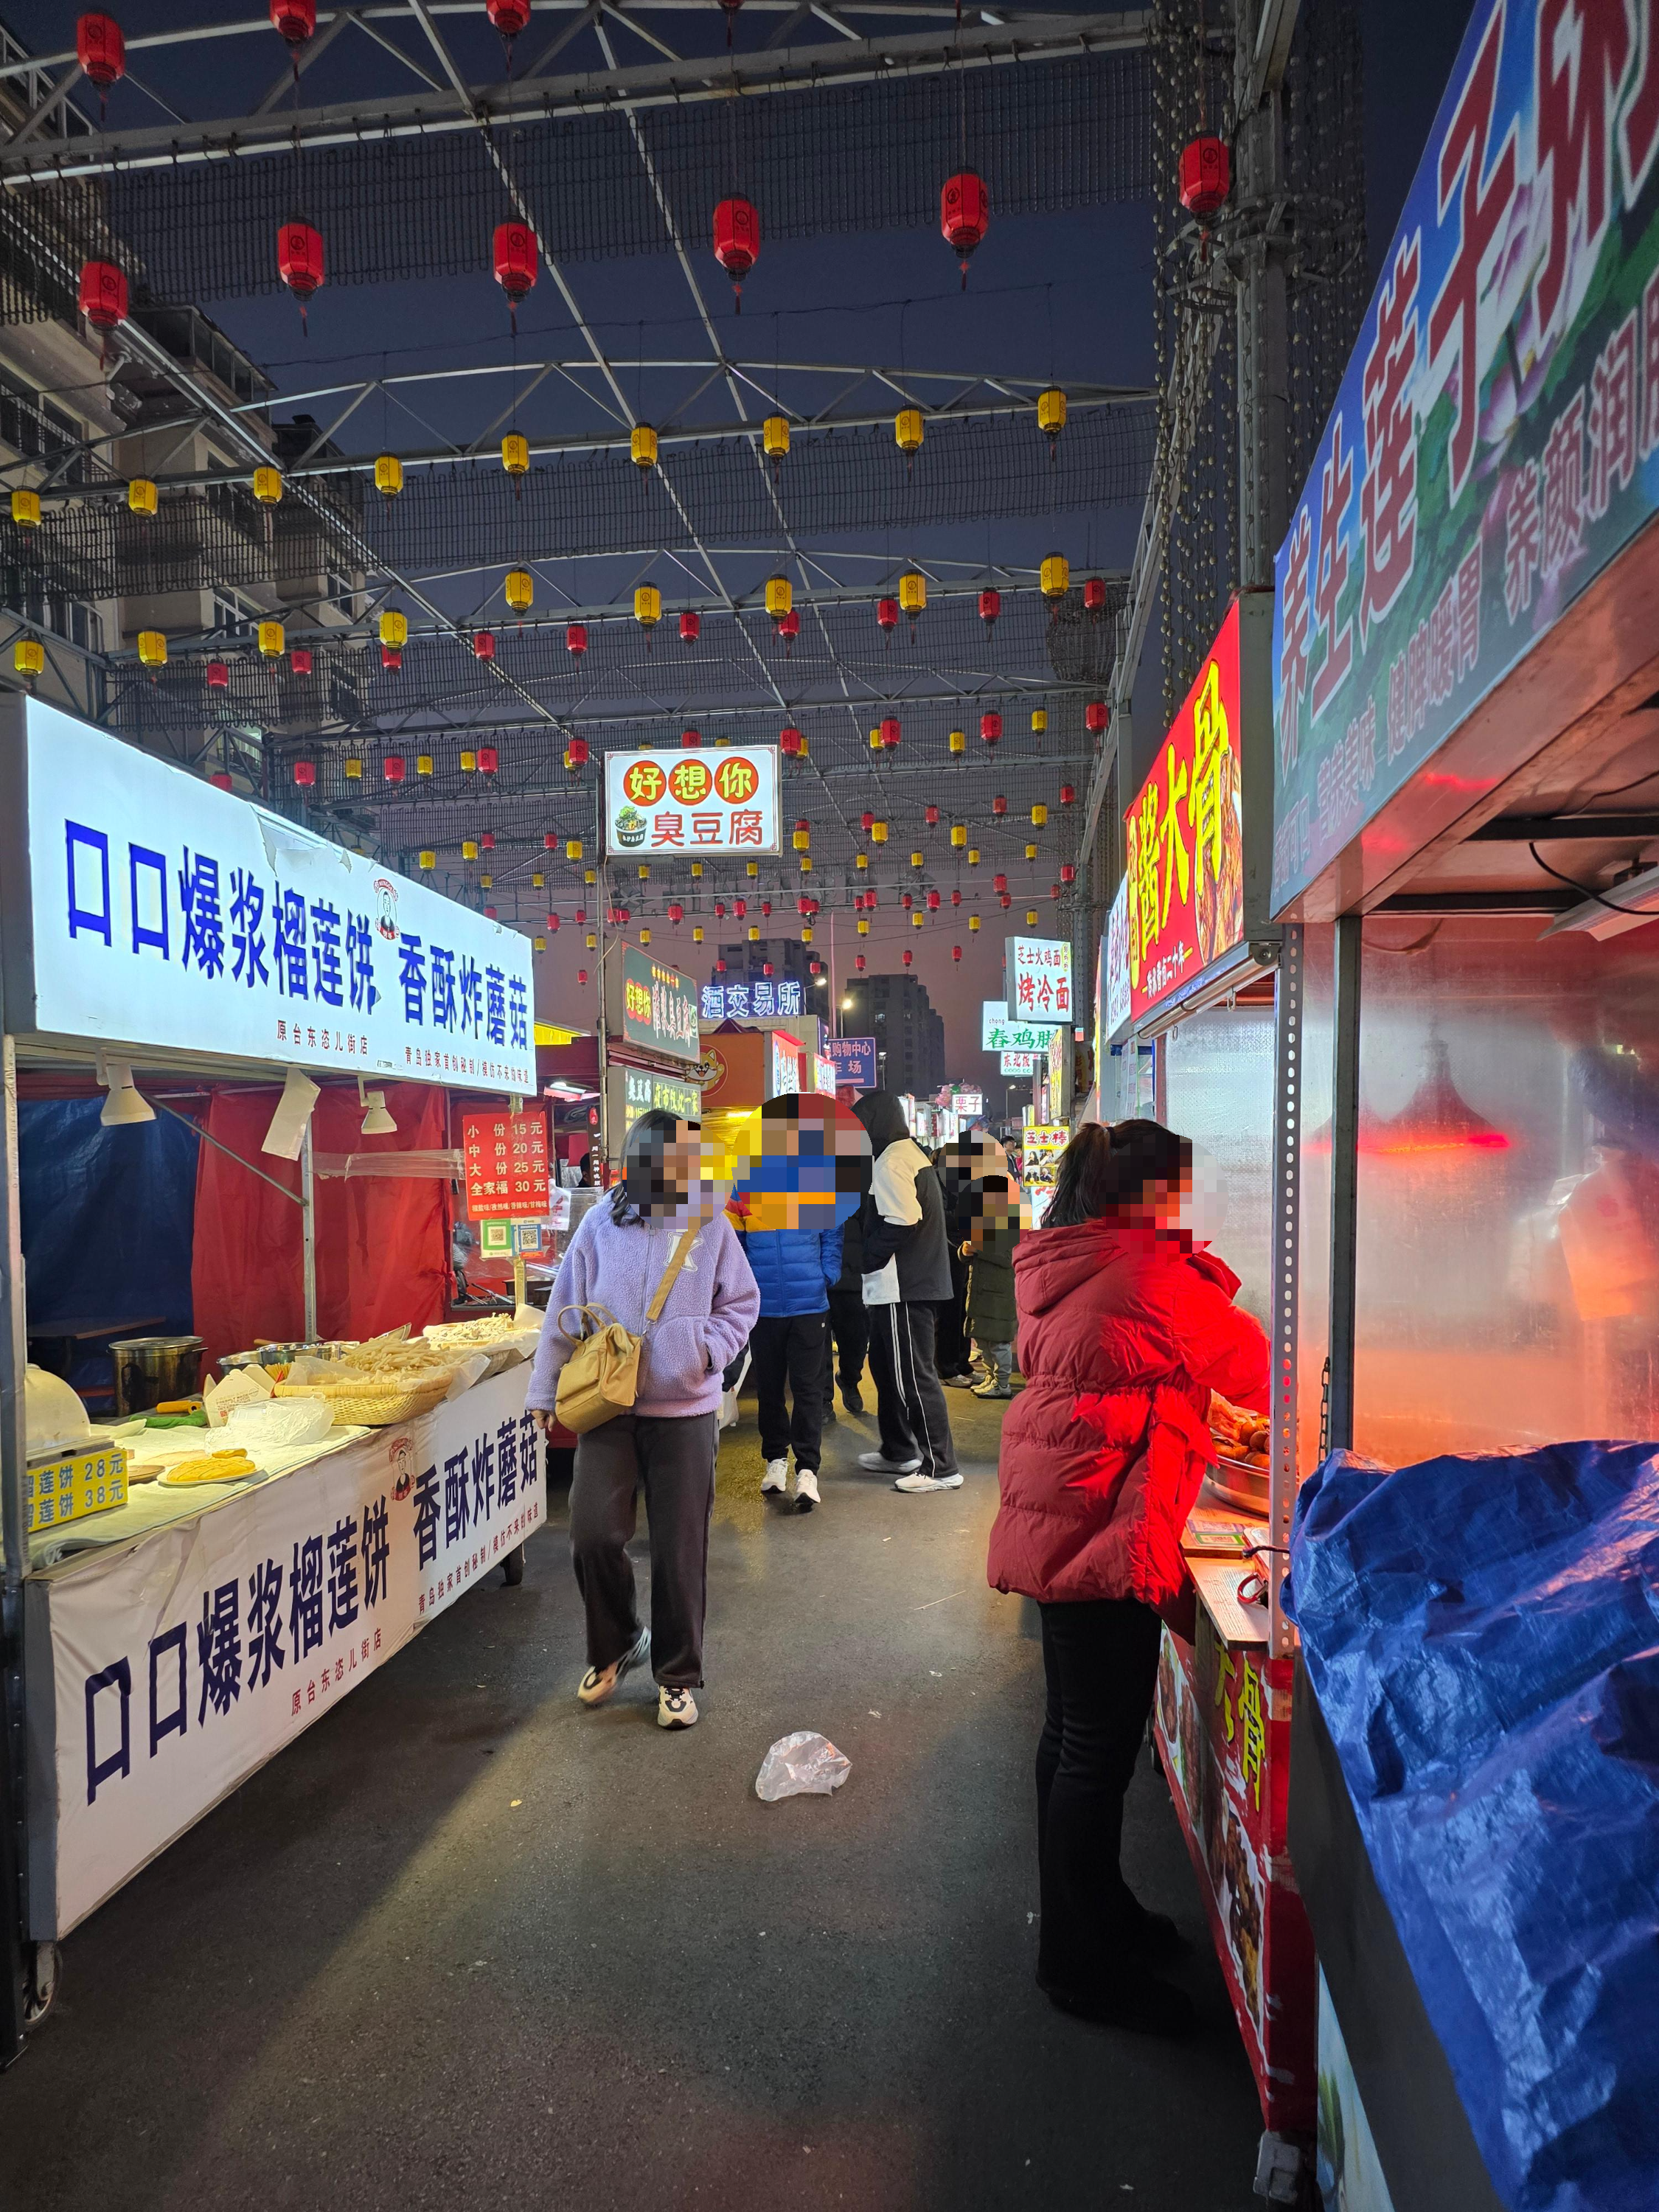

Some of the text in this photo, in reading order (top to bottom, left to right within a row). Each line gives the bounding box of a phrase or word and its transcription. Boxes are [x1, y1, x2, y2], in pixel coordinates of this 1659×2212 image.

[1318, 695, 1377, 846] 营养美味
[1388, 533, 1482, 766] 健脾暖胃
[628, 761, 753, 801] 好想你
[651, 809, 763, 847] 臭豆腐
[1018, 945, 1061, 968] 芝士火鸡面
[398, 933, 528, 1050] 香酥炸蘑菇
[626, 981, 652, 1019] 好想你
[701, 981, 801, 1018] 酒交易所
[1018, 972, 1070, 1013] 烤冷面
[276, 1020, 369, 1056] 原台东恣儿街店
[989, 1018, 1005, 1026] chong
[954, 1096, 981, 1113] 栗子
[1026, 1130, 1068, 1146] 芝士棒
[470, 1180, 508, 1197] 全家福
[414, 1409, 539, 1571] 香酥炸蘑菇
[418, 1503, 539, 1615] 青岛独家首创秘制/模仿不来的味道
[291, 1628, 383, 1717] 原台东恣儿街店
